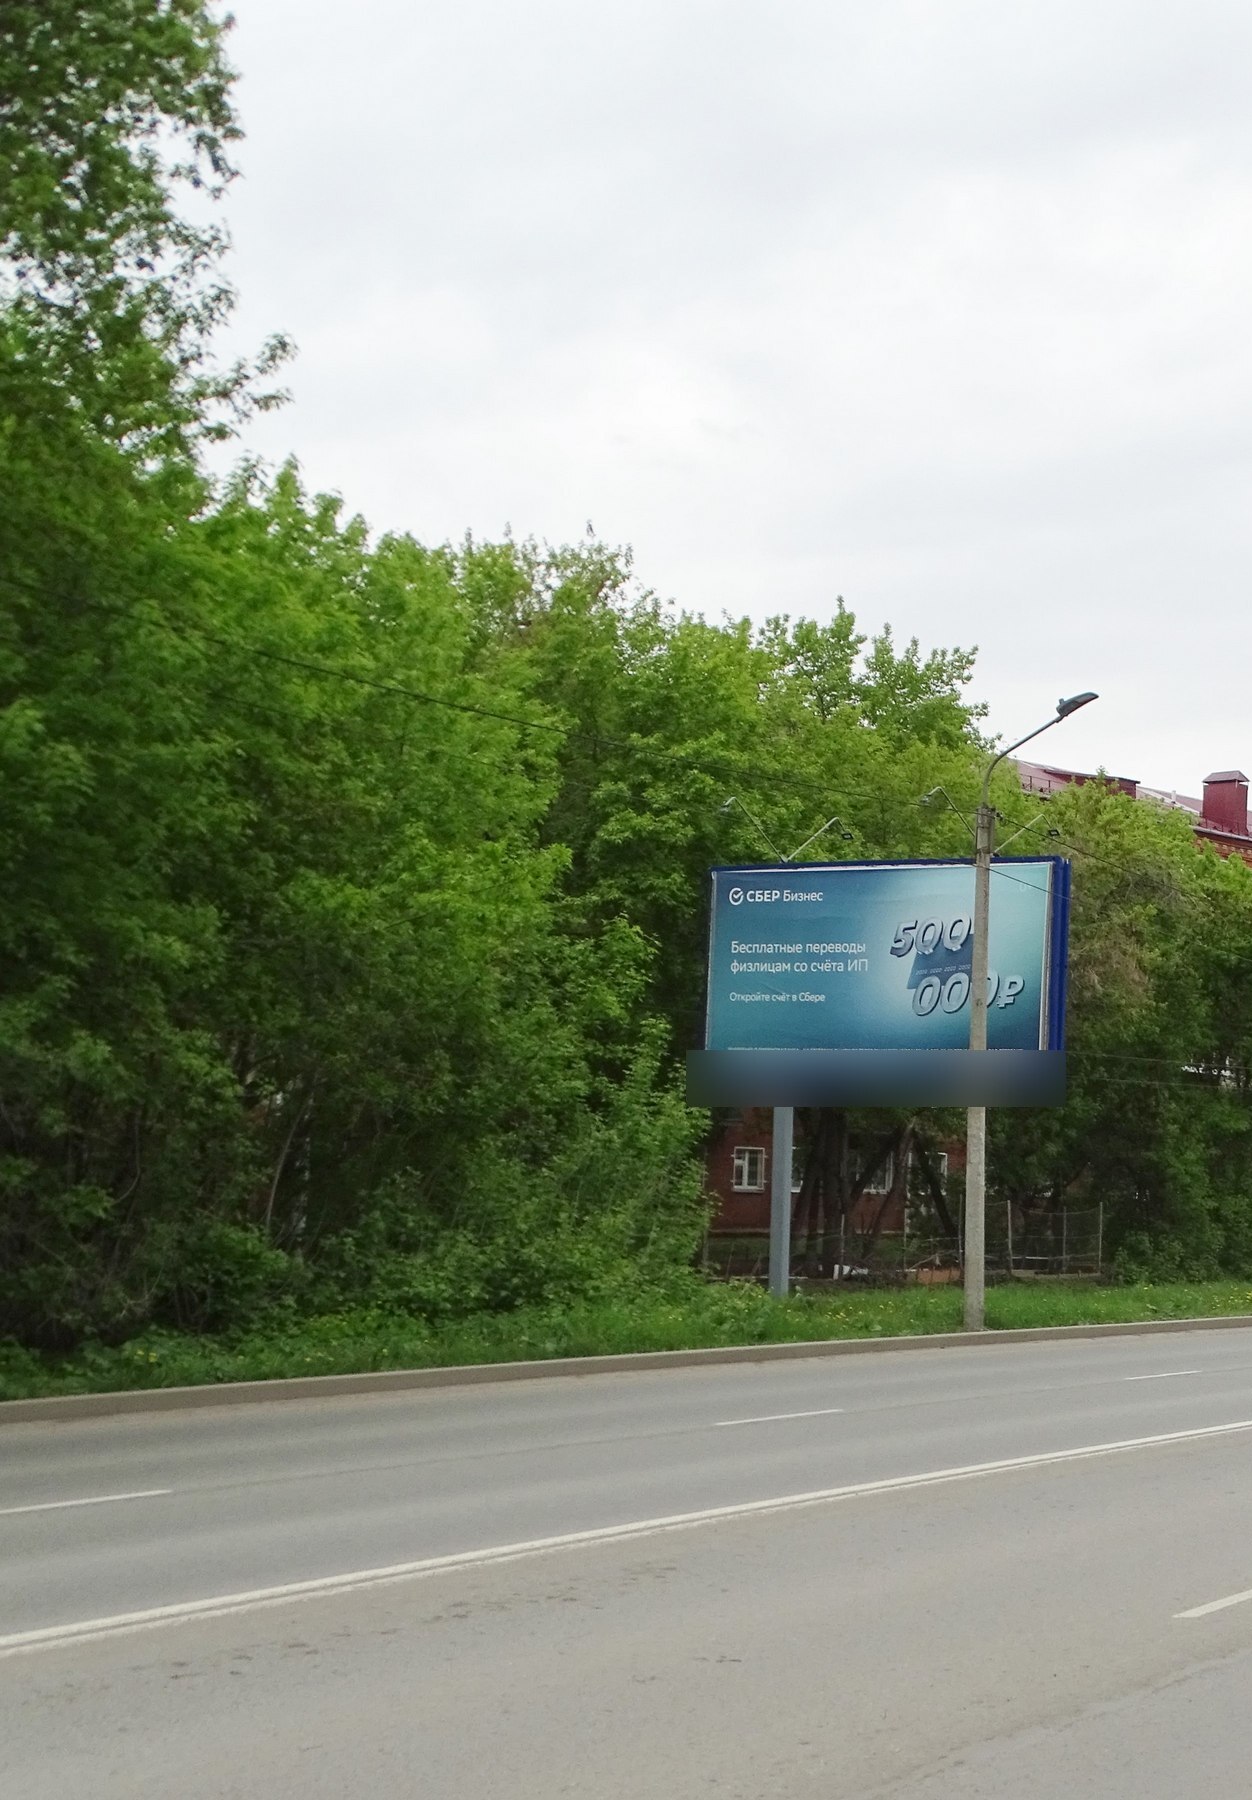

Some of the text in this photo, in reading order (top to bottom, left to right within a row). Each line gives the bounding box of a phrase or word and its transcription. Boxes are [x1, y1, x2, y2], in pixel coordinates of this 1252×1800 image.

[746, 890, 824, 902] СБЕР Бизнес
[889, 914, 971, 957] 500
[731, 940, 866, 955] Бесплатные переводы
[730, 959, 868, 974] физлицам со счёта ИП
[729, 991, 826, 1003] Откройте счёт в Сбере
